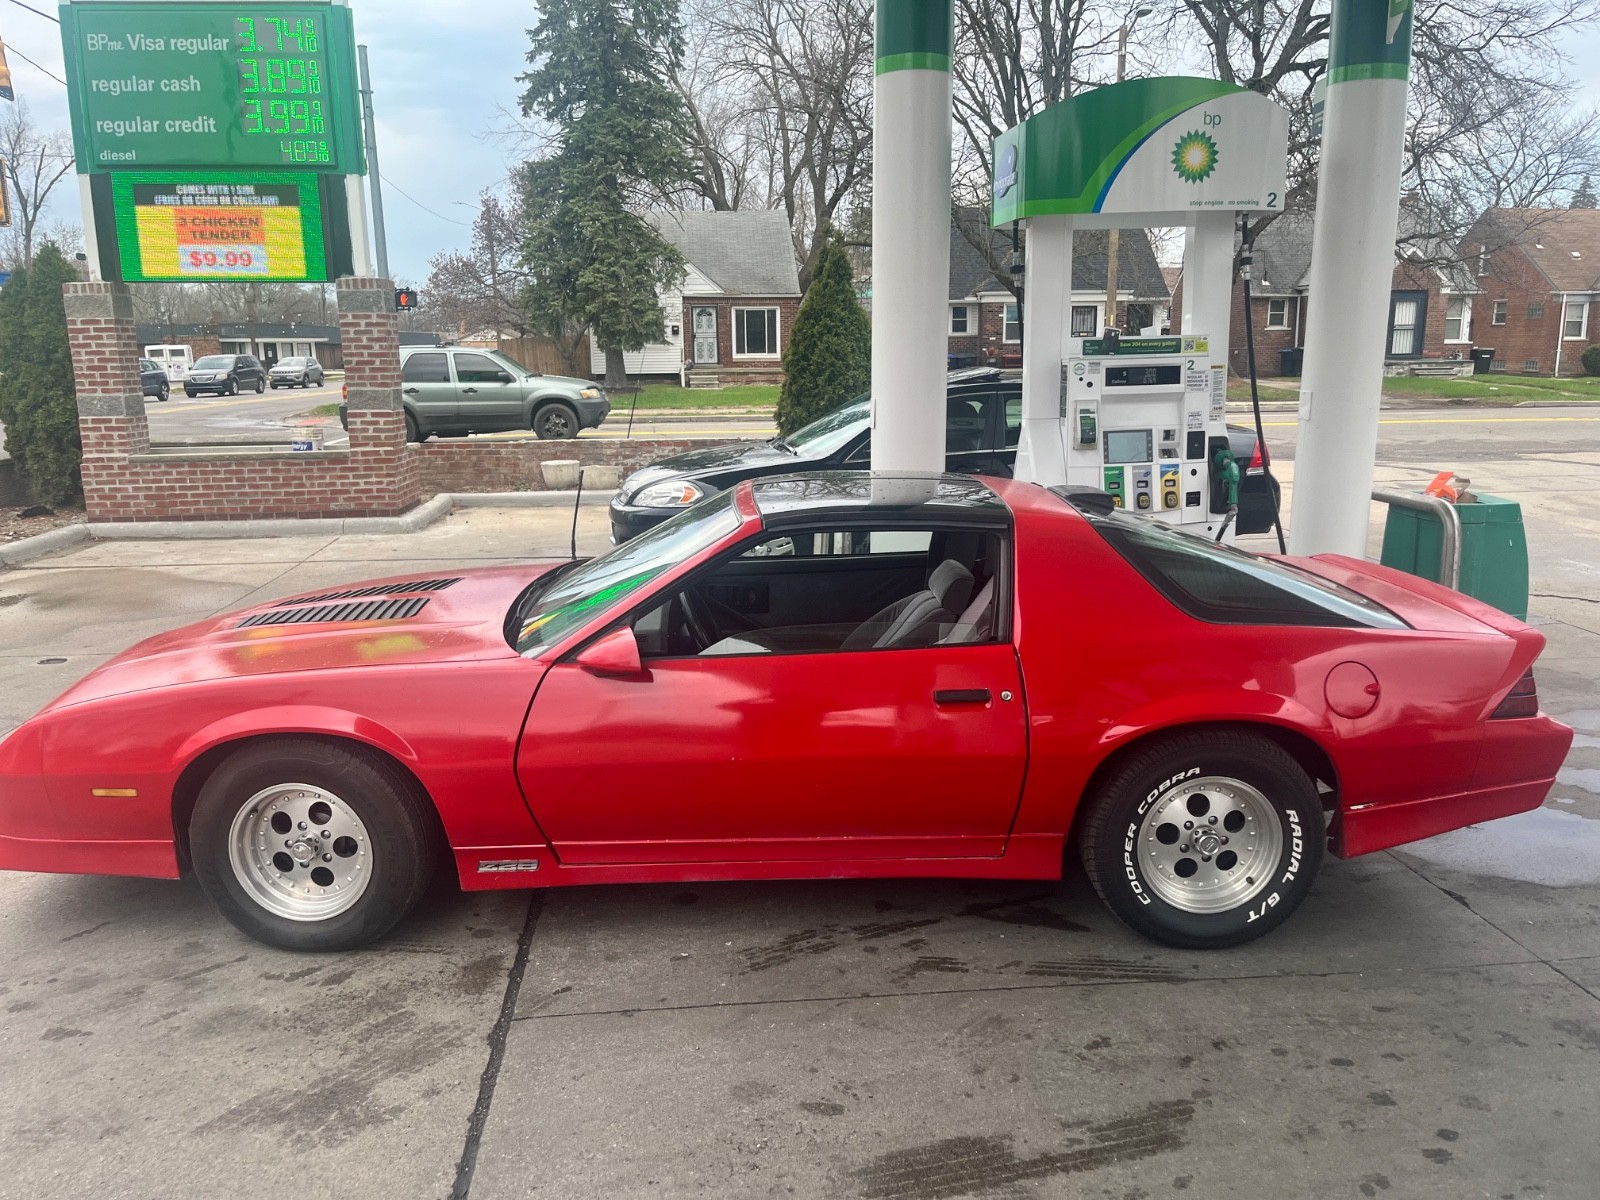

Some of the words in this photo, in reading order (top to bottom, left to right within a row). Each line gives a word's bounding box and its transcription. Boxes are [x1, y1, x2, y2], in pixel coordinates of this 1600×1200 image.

[126, 33, 165, 51] Visa
[170, 33, 230, 55] regular
[237, 17, 303, 52] 3.74
[91, 75, 155, 96] regular
[160, 75, 201, 92] cash
[241, 58, 307, 94] 3.89
[96, 116, 160, 137] regular
[165, 115, 217, 133] credit
[244, 99, 310, 134] 3.99
[1203, 110, 1222, 129] bp
[99, 149, 136, 161] diesel
[1236, 199, 1260, 207] smoking
[1266, 192, 1278, 208] 2
[179, 217, 187, 227] 3
[190, 216, 260, 228] CHICKEN
[190, 230, 250, 241] TENDER
[189, 251, 253, 267] $9.99
[1186, 359, 1196, 371] 2
[1137, 767, 1200, 816] COBRA
[1282, 809, 1303, 884] RADIAL
[477, 859, 539, 872] Z28
[1124, 822, 1152, 905] COOPER
[1246, 892, 1281, 923] G/T
